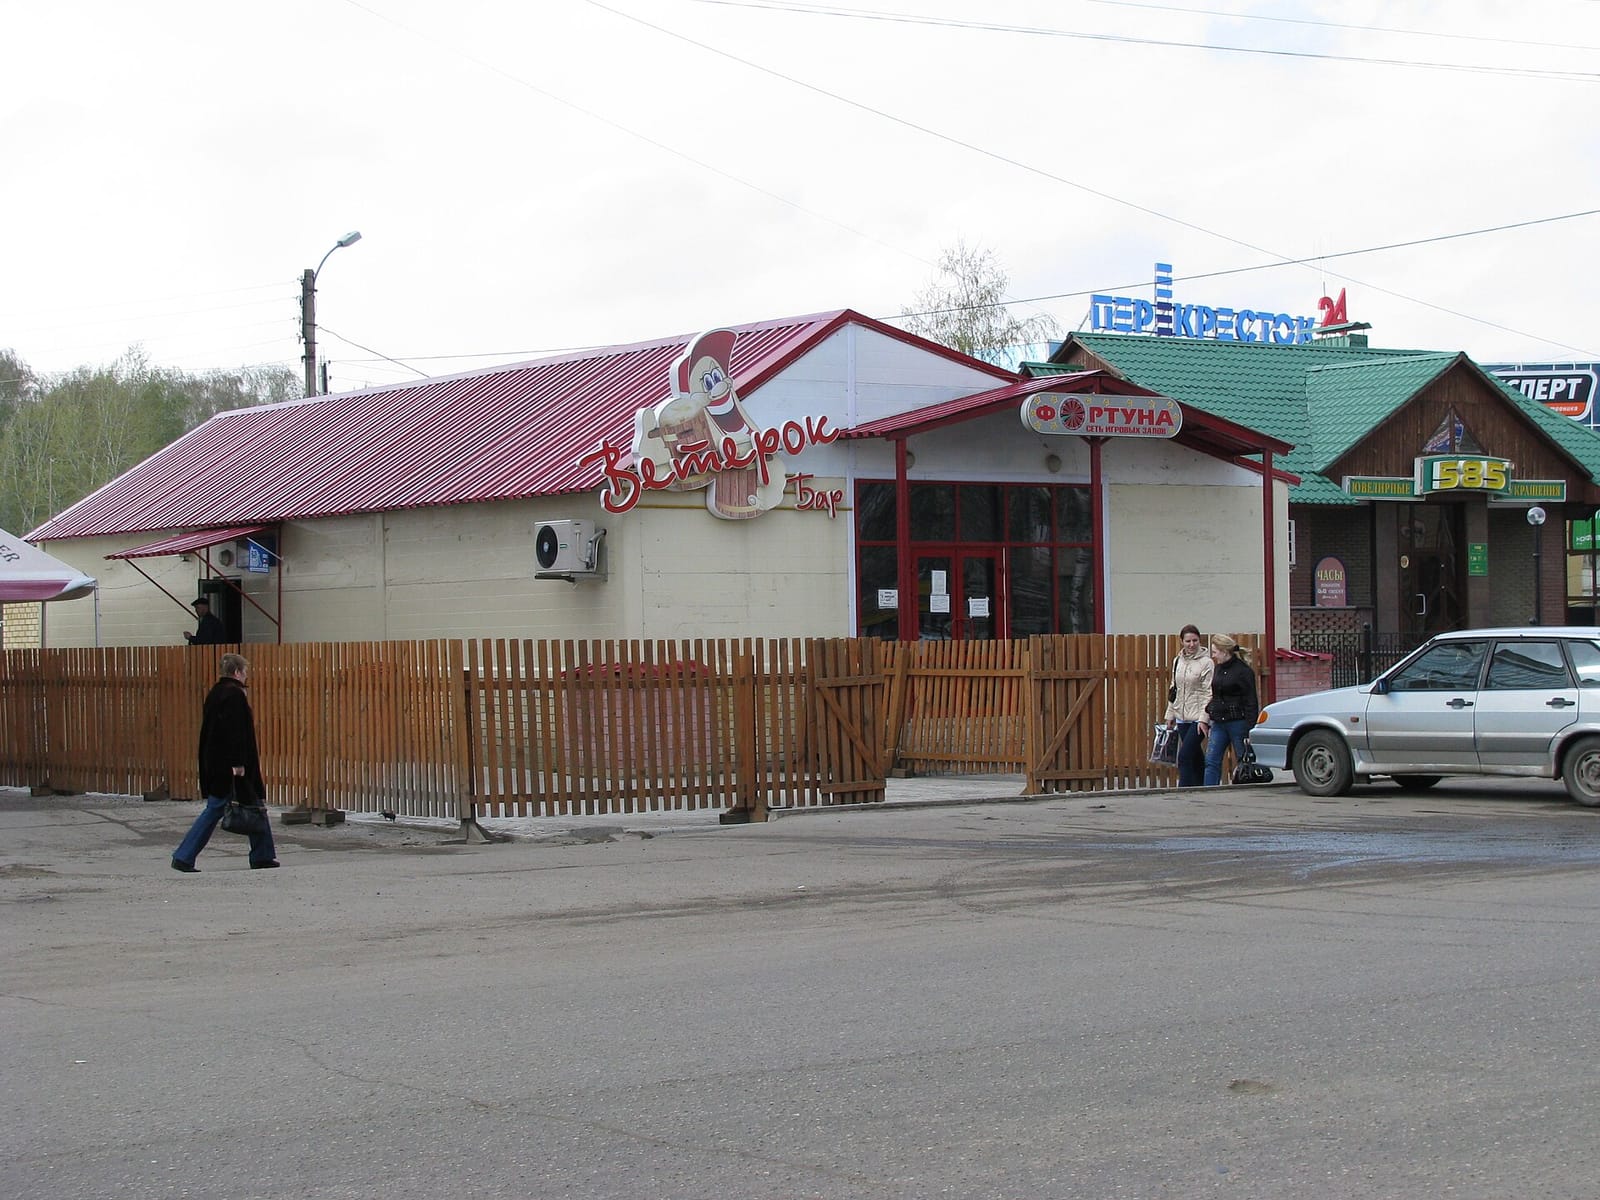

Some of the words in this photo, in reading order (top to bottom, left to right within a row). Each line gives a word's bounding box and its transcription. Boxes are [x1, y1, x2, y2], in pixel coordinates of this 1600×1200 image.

[1091, 263, 1315, 344] ПЕРЕКРЕСТОК
[1318, 288, 1349, 328] 24
[1502, 378, 1582, 400] ПЕРТ
[1036, 401, 1174, 427] ФОРТУНА
[579, 415, 840, 514] Ветерок
[1436, 460, 1506, 490] 585
[786, 473, 844, 519] Бар
[1351, 480, 1411, 495] ЮВЕЛИРНЫЕ
[1317, 569, 1344, 581] ЧАСЫ
